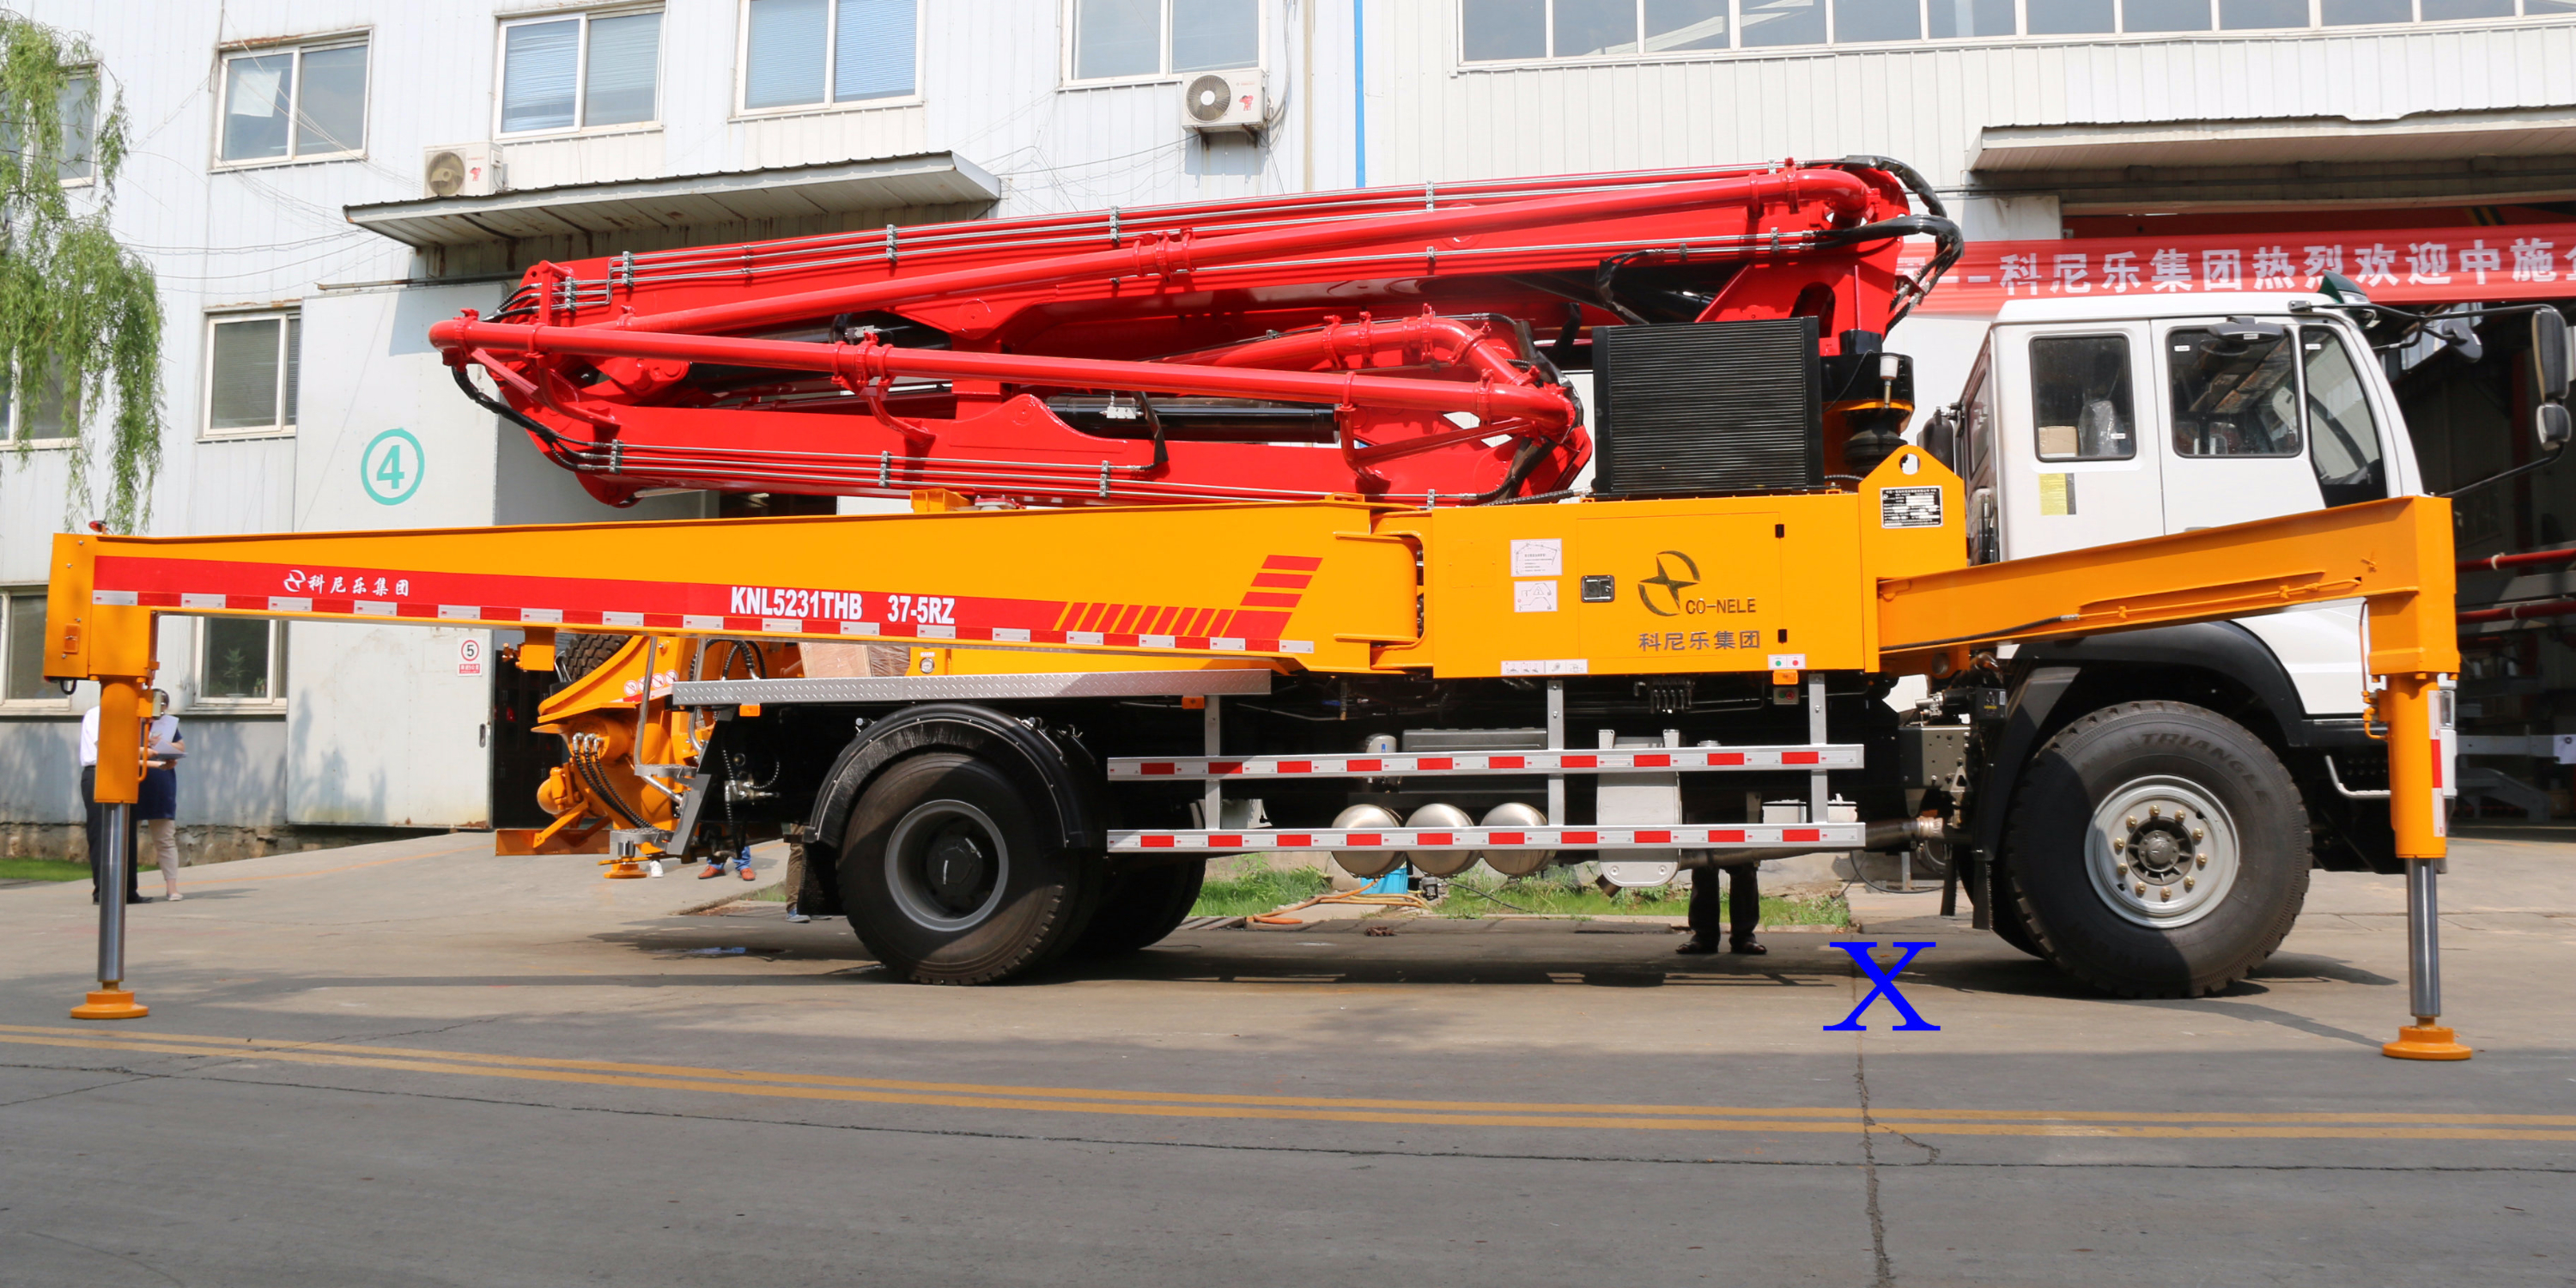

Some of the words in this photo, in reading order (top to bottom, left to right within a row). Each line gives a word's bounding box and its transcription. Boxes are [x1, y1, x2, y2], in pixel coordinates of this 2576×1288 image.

[376, 444, 404, 489] 4
[307, 574, 410, 597] 科尼乐集团
[731, 586, 863, 620] KNL5231THB
[887, 594, 956, 625] 37-5RZ
[1686, 598, 1757, 615] CO-NELE
[466, 644, 475, 657] 5
[1637, 629, 1761, 653] 科尼乐集团
[2141, 732, 2272, 805] TRIANGLE
